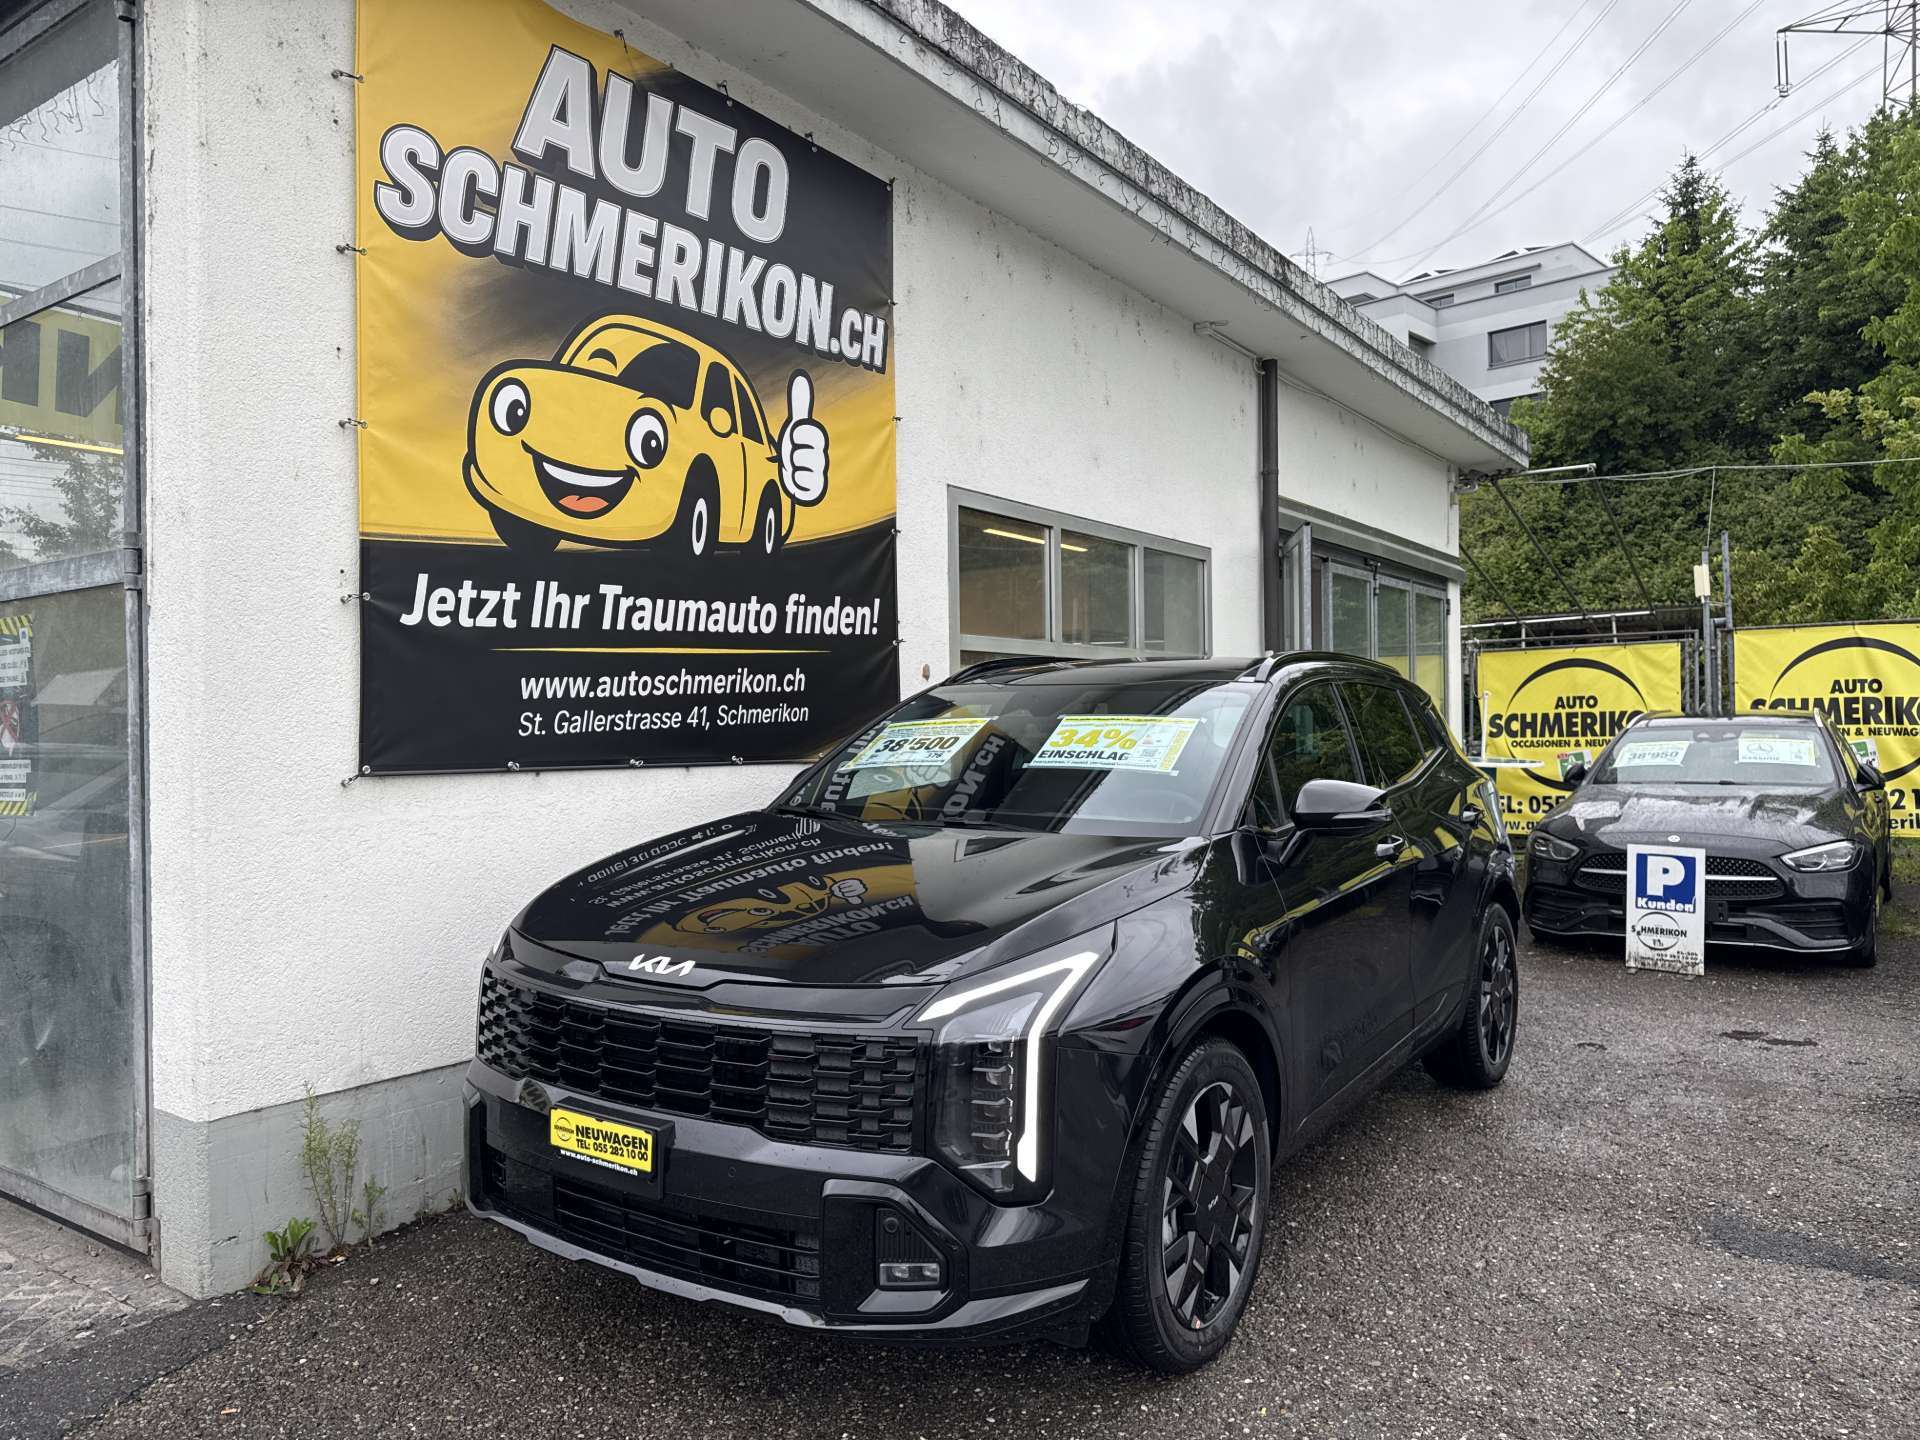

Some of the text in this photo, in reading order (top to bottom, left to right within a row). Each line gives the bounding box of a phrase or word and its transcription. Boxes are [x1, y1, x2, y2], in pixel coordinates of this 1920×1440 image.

[514, 44, 789, 244] AUTO
[374, 125, 888, 370] SCHMERIKON.CH
[399, 573, 881, 636] Jetzt Ihr Traumauto finden!
[520, 668, 806, 701] www.autoschmerikon.ch
[1830, 678, 1883, 694] AUTO
[1554, 695, 1598, 710] AUTO
[517, 703, 809, 737] St. Gallerstrasse 41, Schmerikon
[1855, 727, 1864, 736] &
[875, 736, 959, 753] 38'500
[1049, 728, 1137, 750] 34%
[1511, 739, 1571, 748] OCCASIONEN
[1573, 738, 1581, 748] &
[1646, 854, 1685, 896] P
[1636, 896, 1694, 913] Kunden
[575, 1124, 649, 1152] NEUWAGEN
[575, 1138, 649, 1162] TEL: 055 282 10 00
